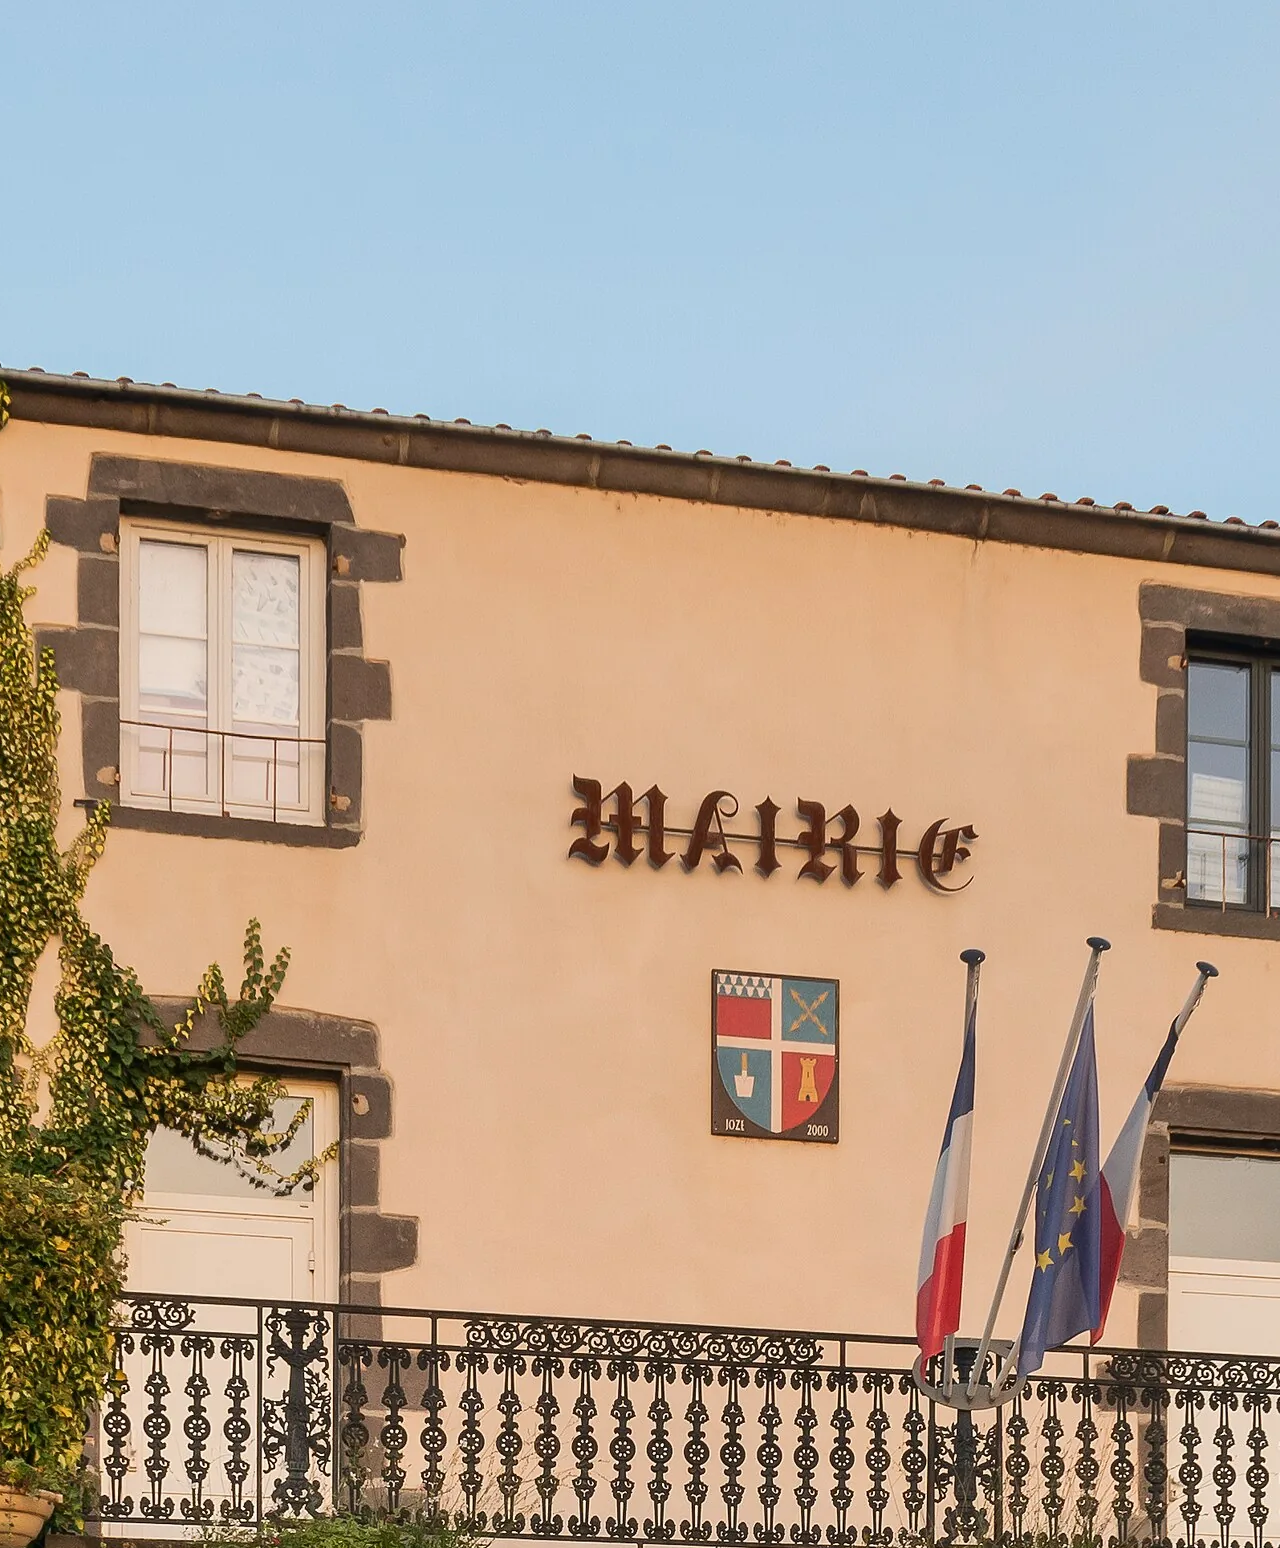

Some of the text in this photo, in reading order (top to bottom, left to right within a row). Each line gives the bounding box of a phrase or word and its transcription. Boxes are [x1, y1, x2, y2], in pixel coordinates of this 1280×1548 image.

[568, 772, 980, 892] MAIRIE
[725, 1118, 745, 1132] JOZE
[807, 1124, 829, 1137] 2000
